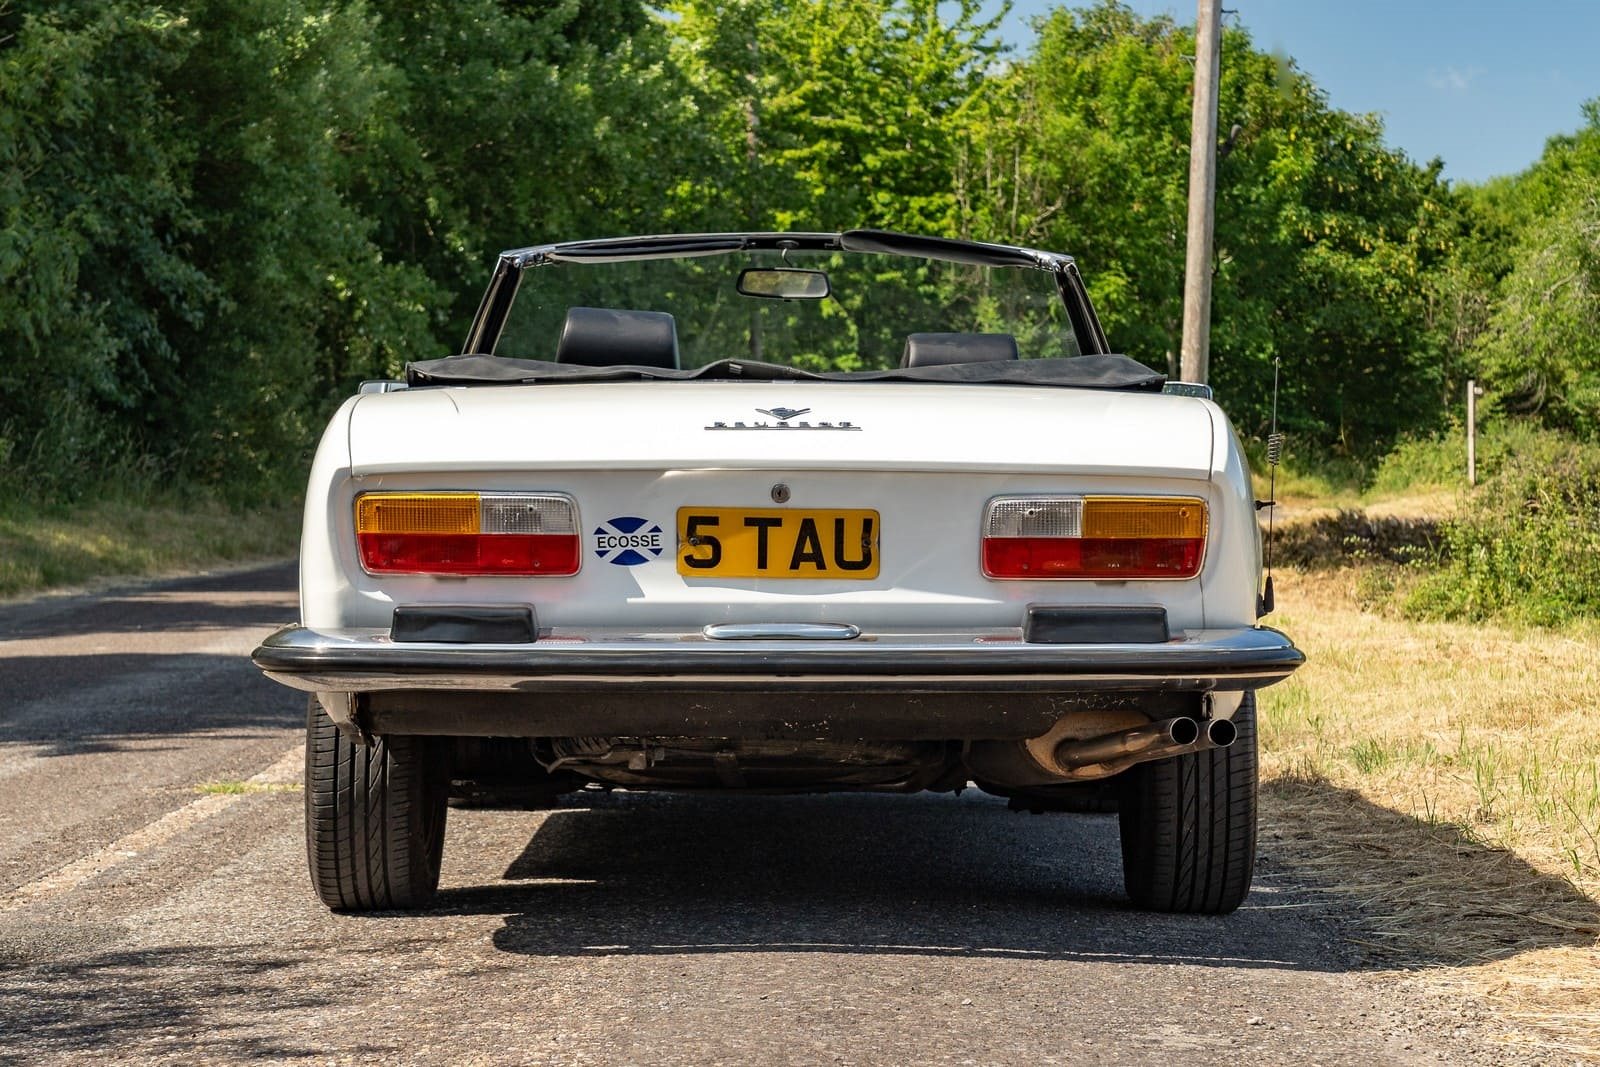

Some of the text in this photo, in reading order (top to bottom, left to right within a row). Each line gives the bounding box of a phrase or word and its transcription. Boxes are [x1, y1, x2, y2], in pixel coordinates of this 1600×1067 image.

[597, 535, 660, 549] ECOSSE
[683, 516, 874, 571] 5 TAU
